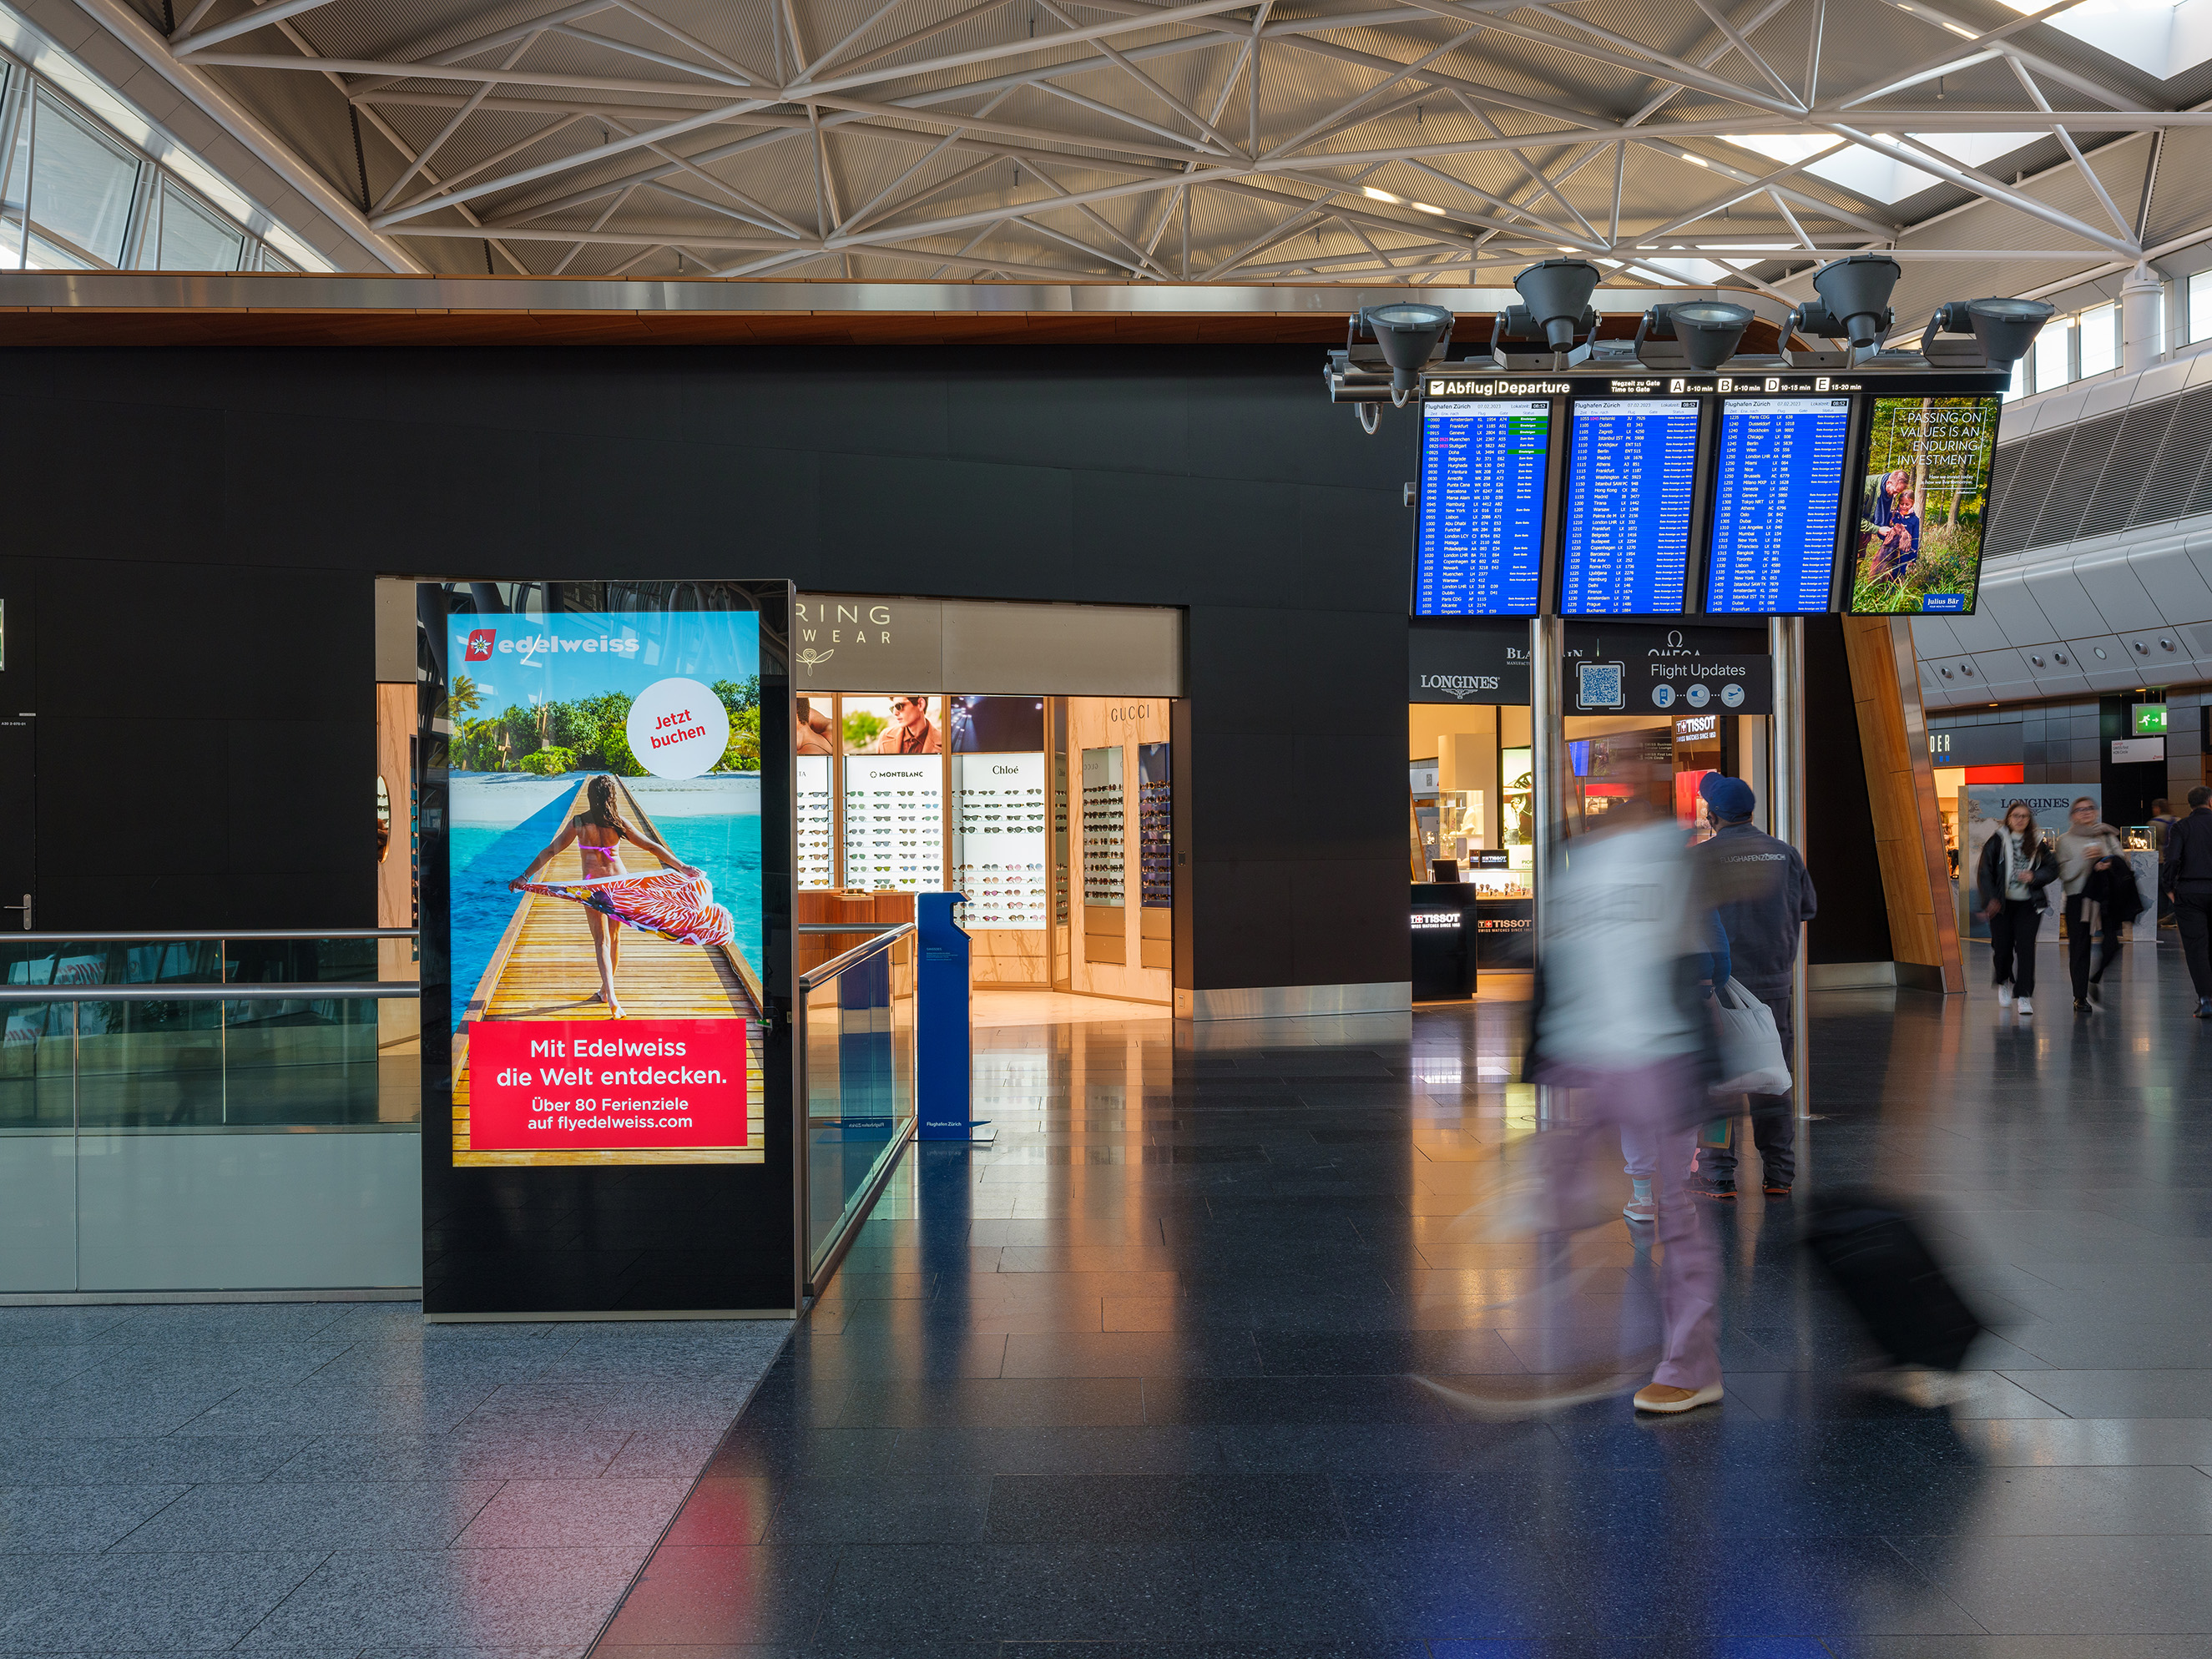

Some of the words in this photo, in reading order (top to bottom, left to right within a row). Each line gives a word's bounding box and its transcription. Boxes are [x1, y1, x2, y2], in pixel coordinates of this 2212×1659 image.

[1446, 381, 1493, 396] Abflug
[1498, 381, 1570, 395] Departure
[1907, 412, 1959, 423] PASSING
[1962, 412, 1981, 423] ON
[1901, 426, 1946, 436] VALUES
[1948, 426, 1959, 436] IS
[1962, 426, 1980, 436] AN
[1912, 441, 1977, 451] ENDURING
[1897, 454, 1975, 465] INVESTMENT.
[498, 633, 639, 654] edelweiss
[1651, 663, 1687, 678] Flight
[1690, 664, 1745, 679] Updates
[1421, 675, 1498, 690] LONGINES
[654, 708, 692, 730] Jetzt
[1110, 704, 1150, 723] GUCCI
[650, 724, 706, 749] buchen
[992, 765, 1018, 775] Chloé
[2001, 799, 2069, 808] LONGINES
[531, 1040, 565, 1057] Mit
[573, 1038, 686, 1057] Edelweiss
[497, 1069, 532, 1087] die
[539, 1067, 593, 1086] Welt
[601, 1066, 727, 1085] entdecken.
[532, 1097, 569, 1112] Über
[575, 1098, 596, 1112] 80
[602, 1097, 689, 1112] Ferienziele
[528, 1115, 553, 1130] auf
[558, 1115, 692, 1132] flyedelweiss.com
